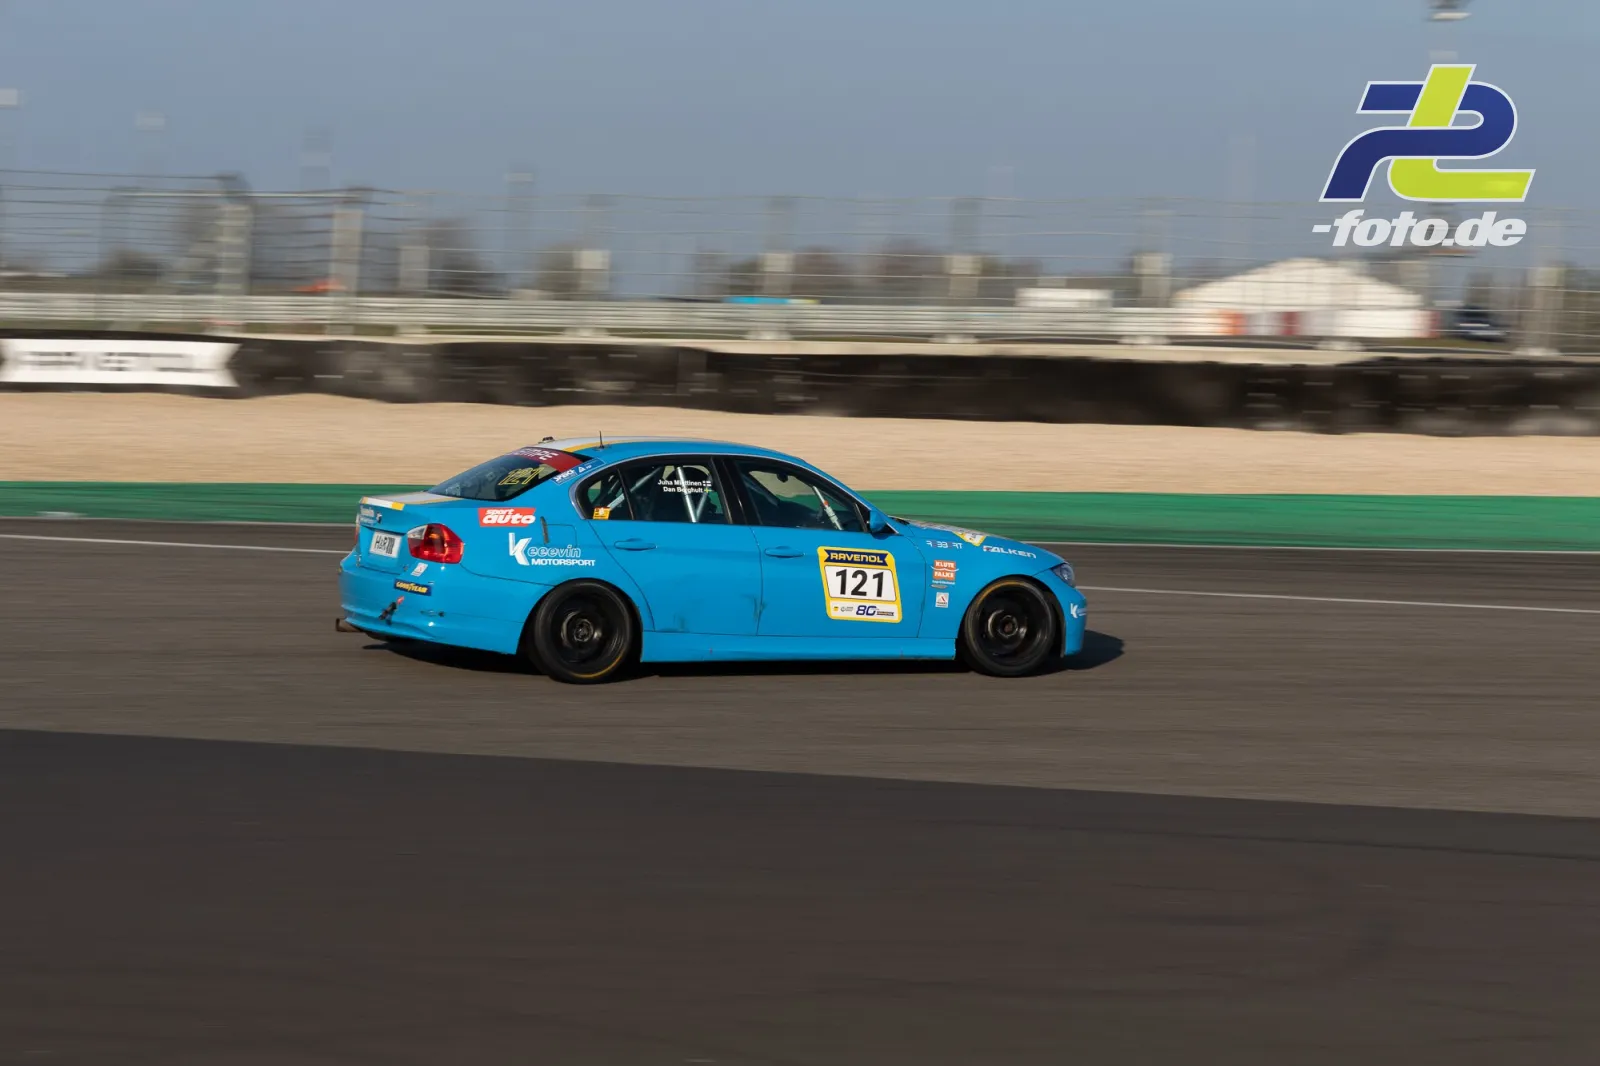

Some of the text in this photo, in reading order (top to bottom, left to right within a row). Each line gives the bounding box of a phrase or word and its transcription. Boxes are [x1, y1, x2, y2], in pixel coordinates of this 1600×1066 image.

[482, 514, 537, 524] auto
[830, 552, 884, 563] RAVENOL
[982, 545, 1037, 559] FALKEN
[531, 558, 596, 567] MOTORSPORT
[835, 568, 884, 598] 121
